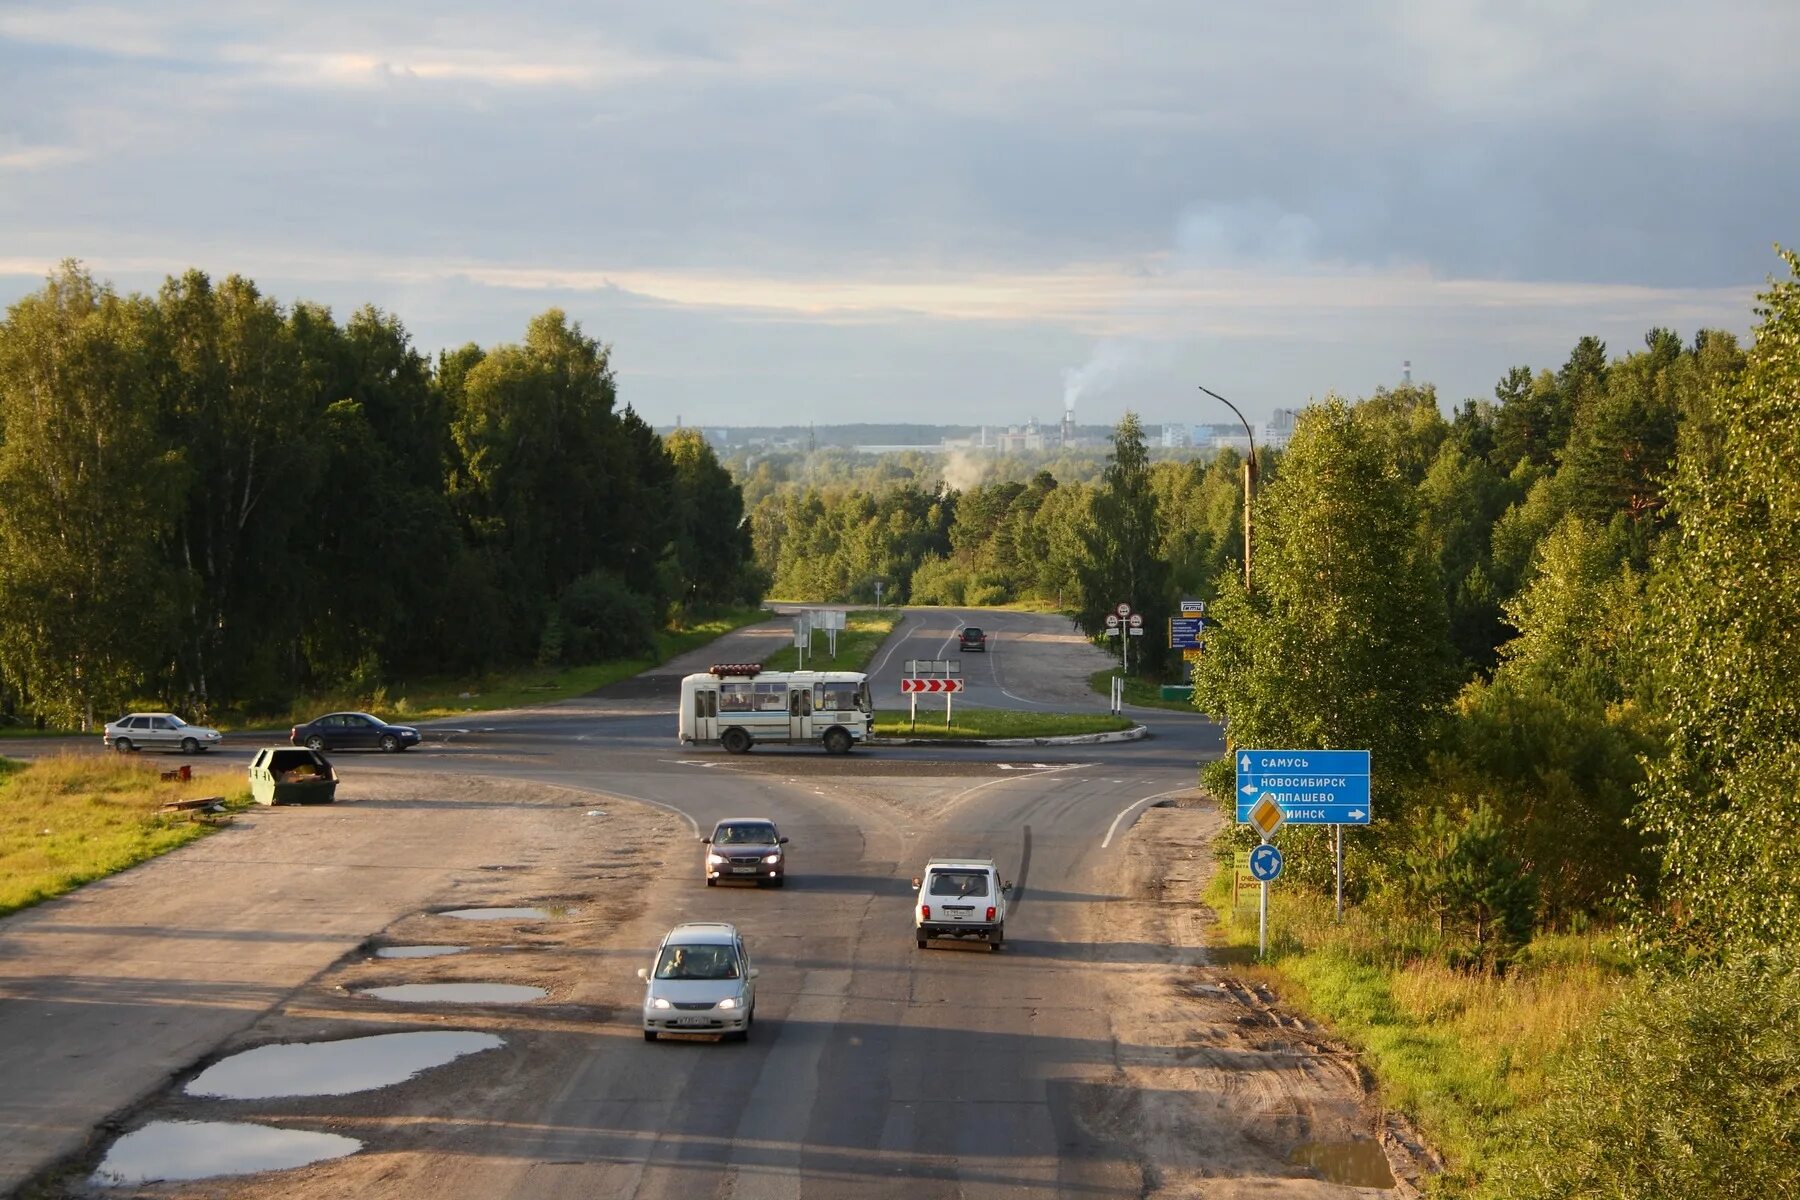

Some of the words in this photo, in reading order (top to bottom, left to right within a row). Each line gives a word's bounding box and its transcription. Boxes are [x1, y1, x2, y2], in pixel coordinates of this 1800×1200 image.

[1261, 758, 1309, 768] САМУСЬ
[1261, 777, 1346, 788] НОВОСИБИРСК
[1269, 793, 1335, 802] ОЛПАШЕВО
[1286, 809, 1325, 819] ИИНСК
